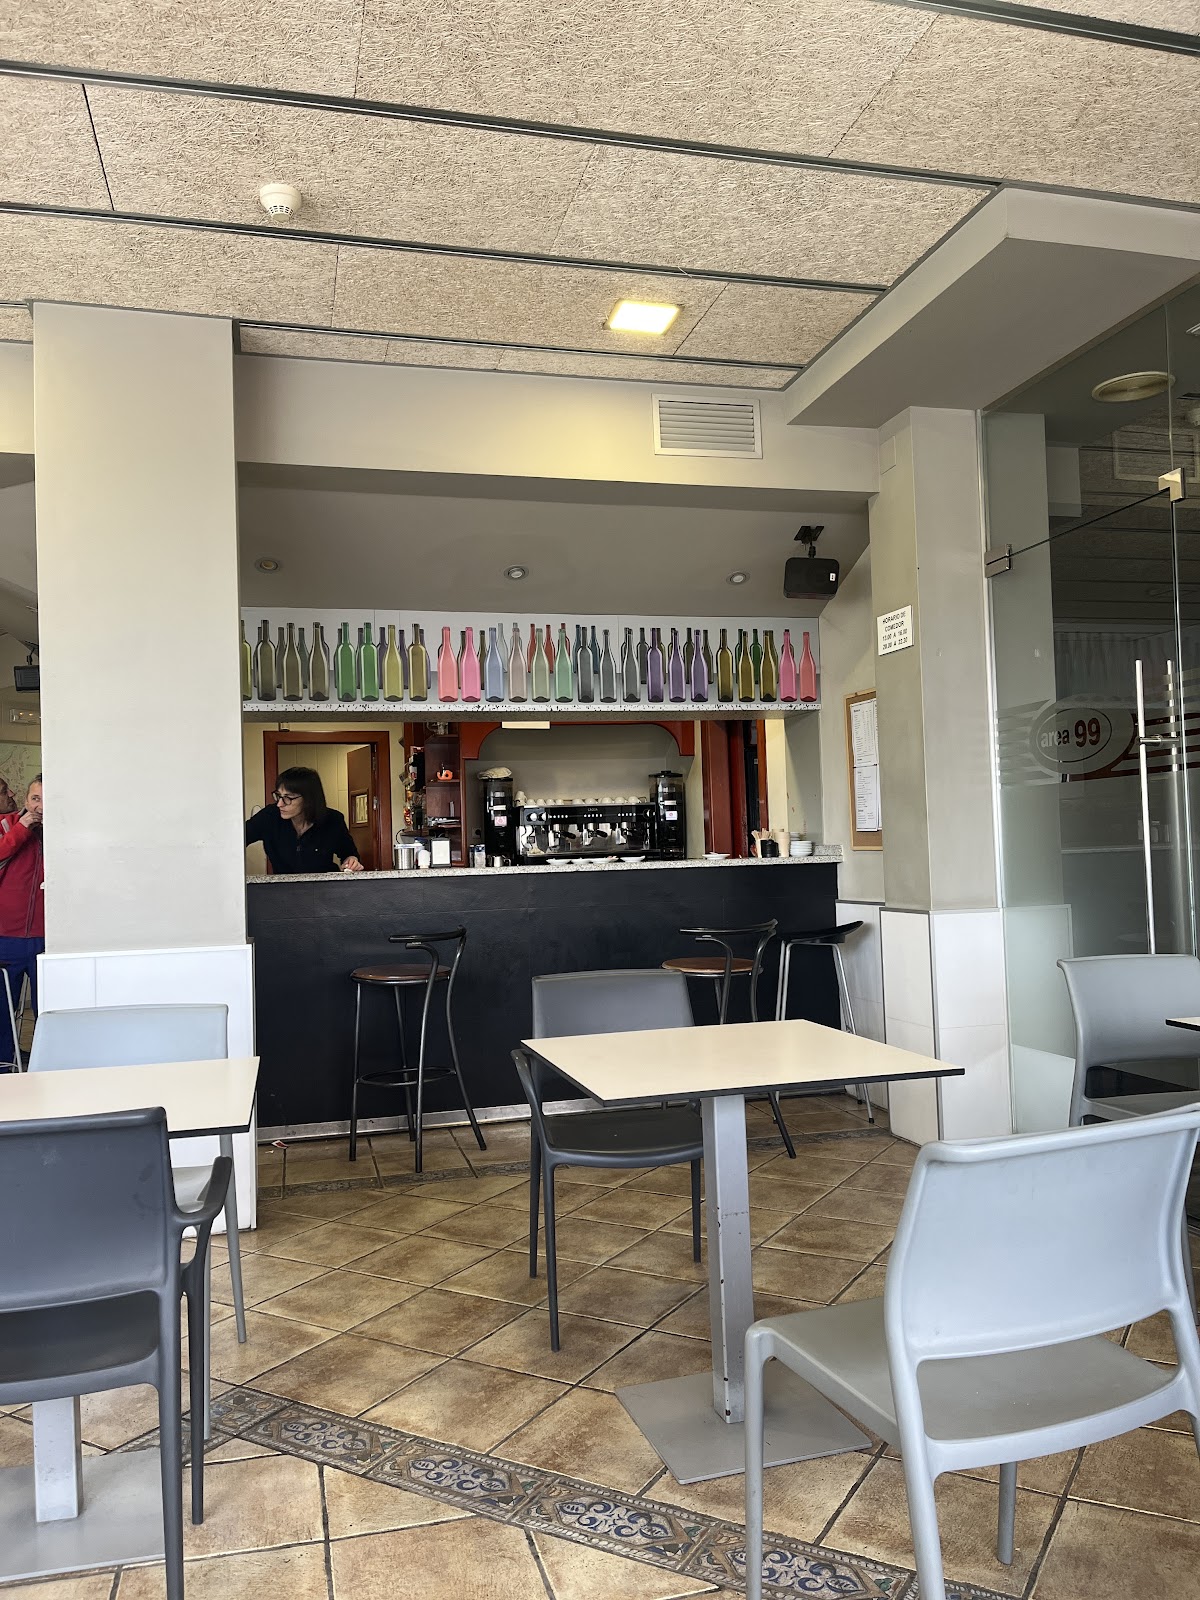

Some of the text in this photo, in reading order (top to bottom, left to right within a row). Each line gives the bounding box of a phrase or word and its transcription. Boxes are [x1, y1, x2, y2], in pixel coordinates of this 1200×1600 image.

[885, 620, 904, 632] COMEDOR
[1041, 717, 1101, 748] area 99
